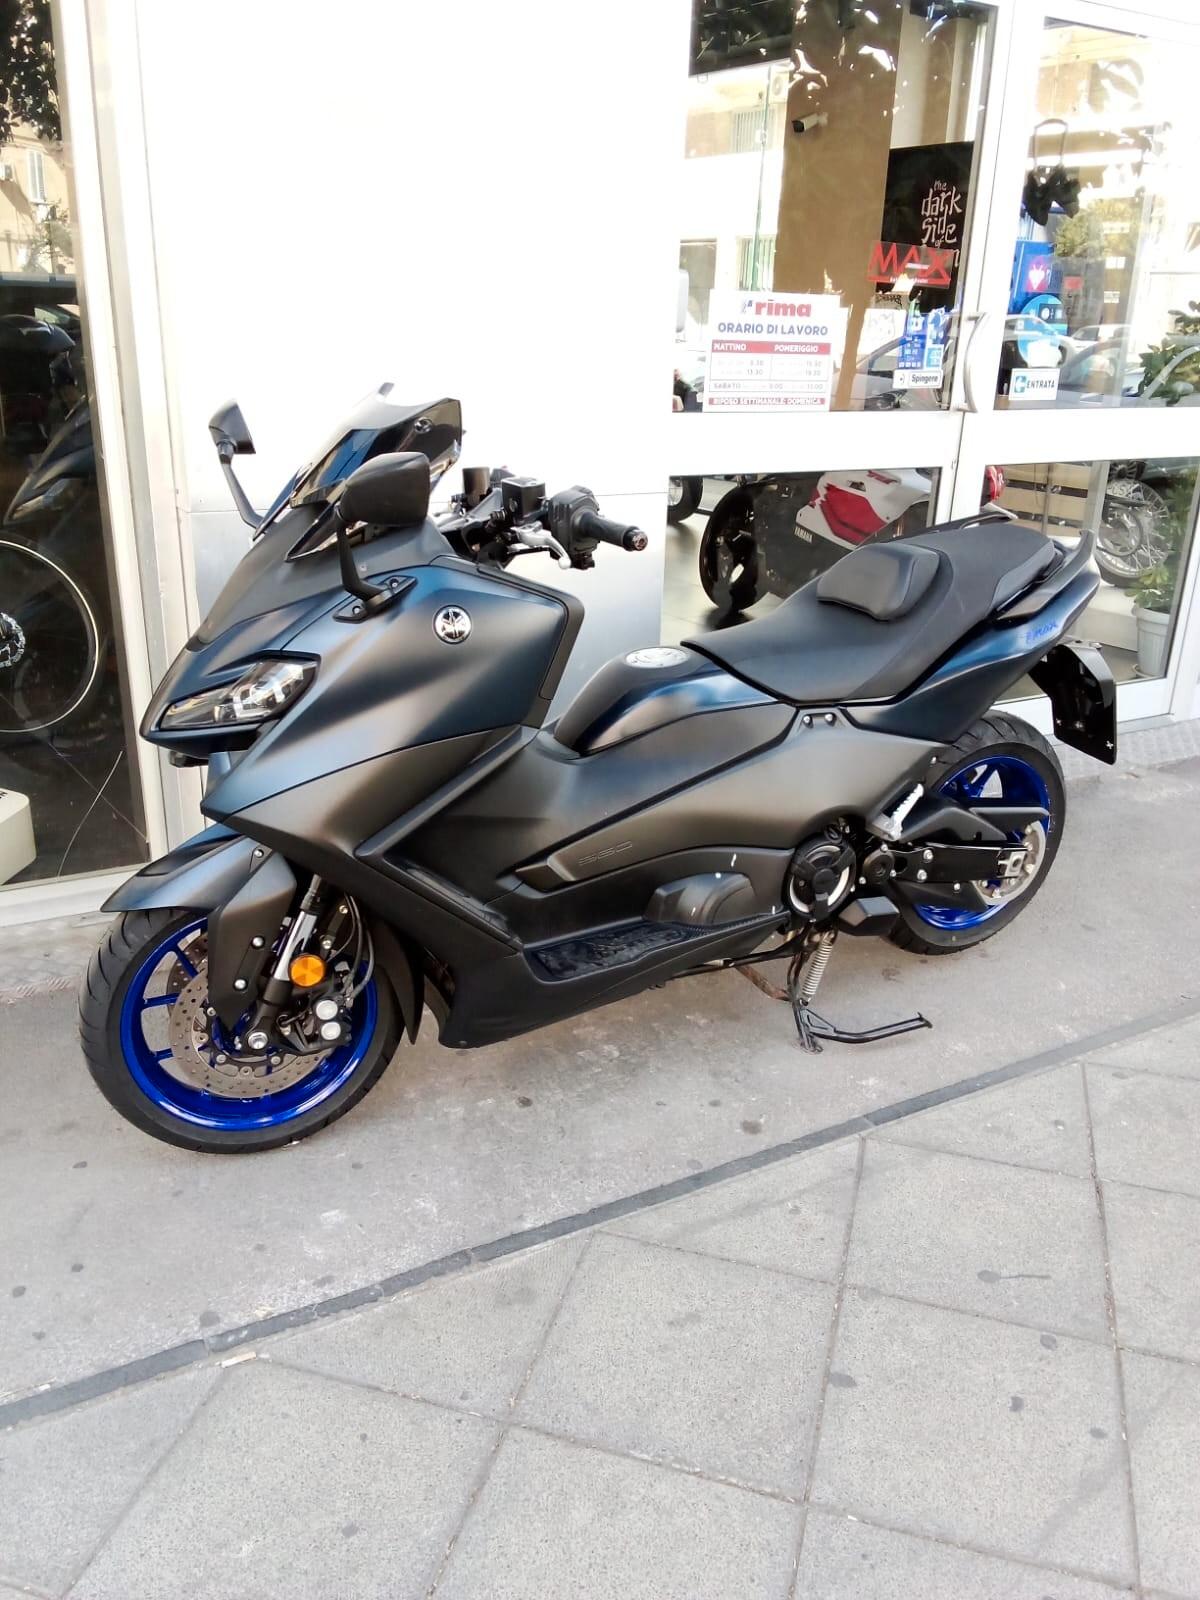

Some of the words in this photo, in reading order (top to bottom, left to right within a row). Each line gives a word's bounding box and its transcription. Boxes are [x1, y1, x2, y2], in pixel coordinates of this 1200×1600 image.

[921, 186, 963, 217] dark
[920, 205, 957, 243] side
[717, 322, 764, 335] ORARIO
[766, 324, 778, 335] DI
[780, 325, 829, 336] LAVORO
[713, 343, 747, 352] MATTINO
[774, 344, 819, 353] POMERIGGIO
[911, 370, 939, 384] Spingere
[1027, 379, 1055, 389] ENTRATA
